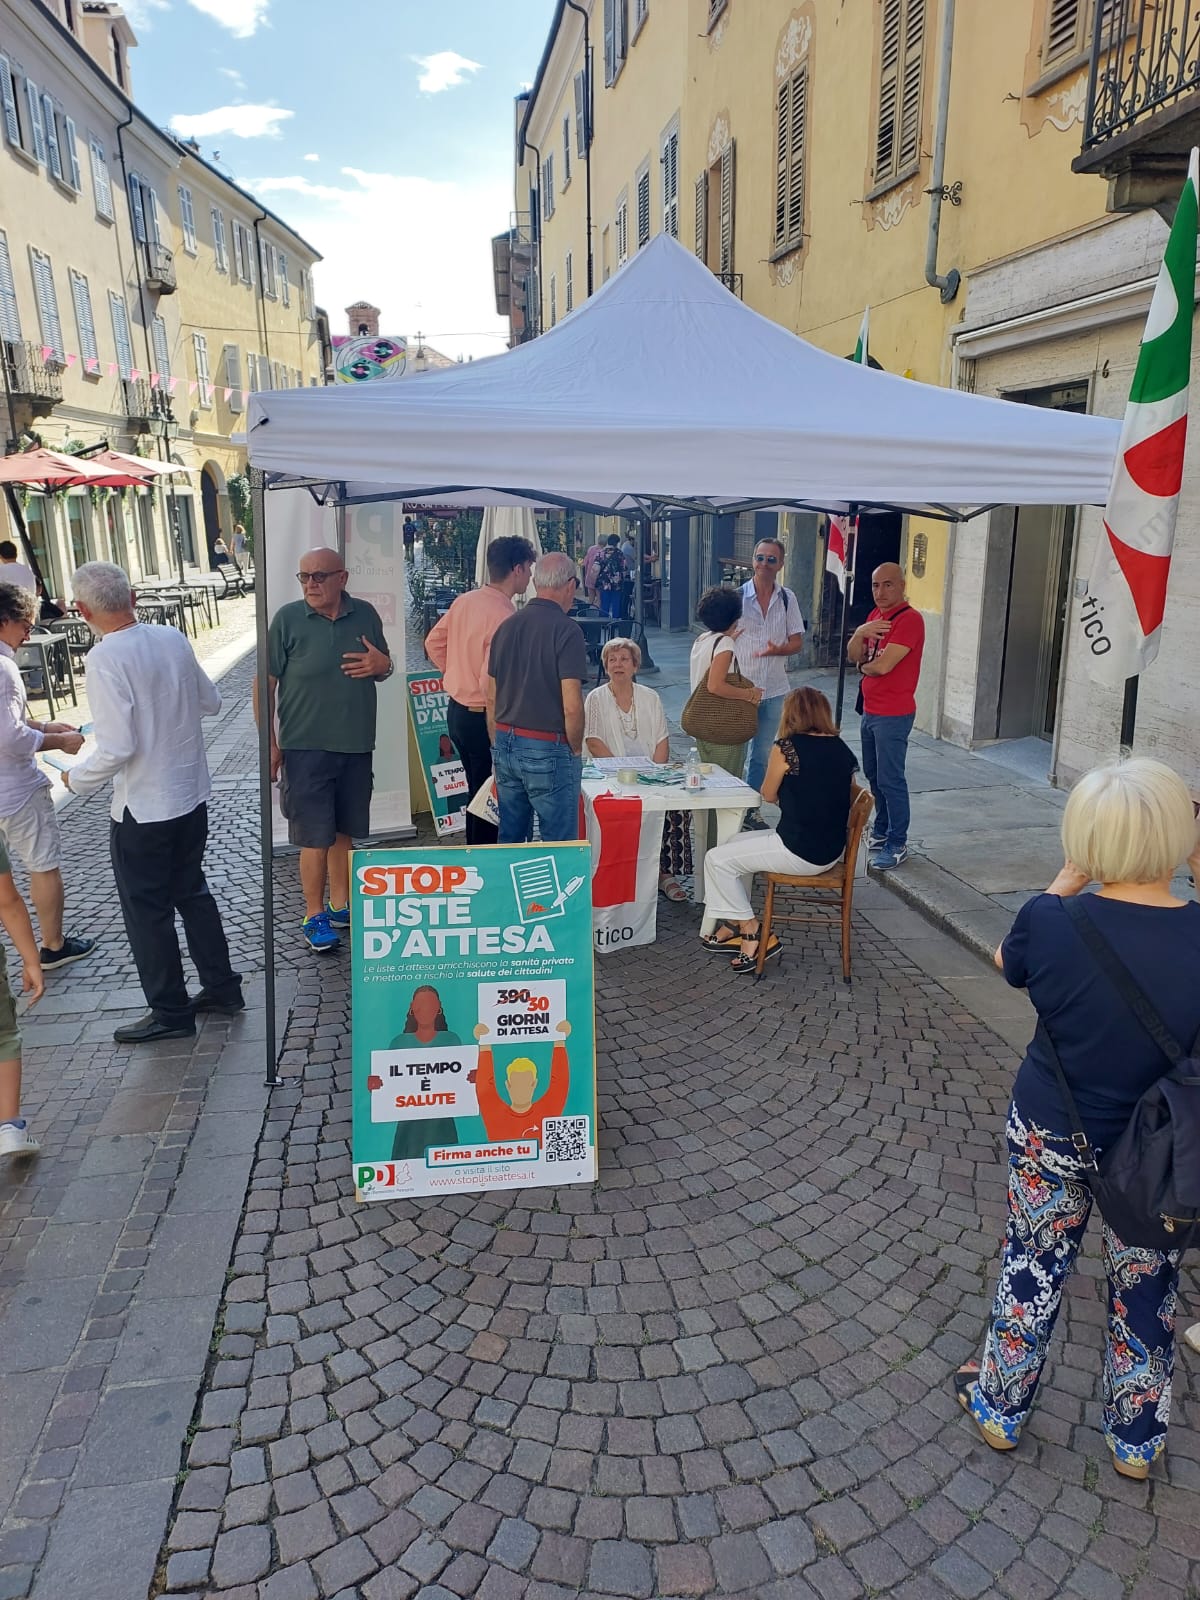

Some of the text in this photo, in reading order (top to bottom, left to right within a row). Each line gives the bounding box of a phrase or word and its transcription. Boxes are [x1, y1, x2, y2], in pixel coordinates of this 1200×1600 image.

[443, 781, 466, 791] SALUTE
[362, 865, 467, 896] STOP
[363, 896, 472, 927] LISTE
[363, 924, 555, 960] D'ATTESA
[364, 956, 575, 974] Le liste d'attesa arricchiscono la sanità privata
[372, 973, 413, 982] mettono
[424, 970, 453, 980] rischio
[455, 970, 464, 978] la
[467, 969, 496, 978] salute
[498, 968, 512, 977] dei
[514, 966, 553, 976] cittadini
[527, 996, 550, 1012] 30
[497, 1013, 550, 1026] GIORNI
[497, 1025, 549, 1036] DI ATTESA
[389, 1061, 462, 1077] IL TEMPO
[420, 1077, 431, 1092] È
[395, 1093, 456, 1108] SALUTE
[433, 1144, 531, 1161] Firma anche tu
[454, 1168, 461, 1176] o
[462, 1166, 485, 1175] visita
[496, 1164, 511, 1173] sito
[430, 1171, 536, 1188] www.stoplisteattesa.it
